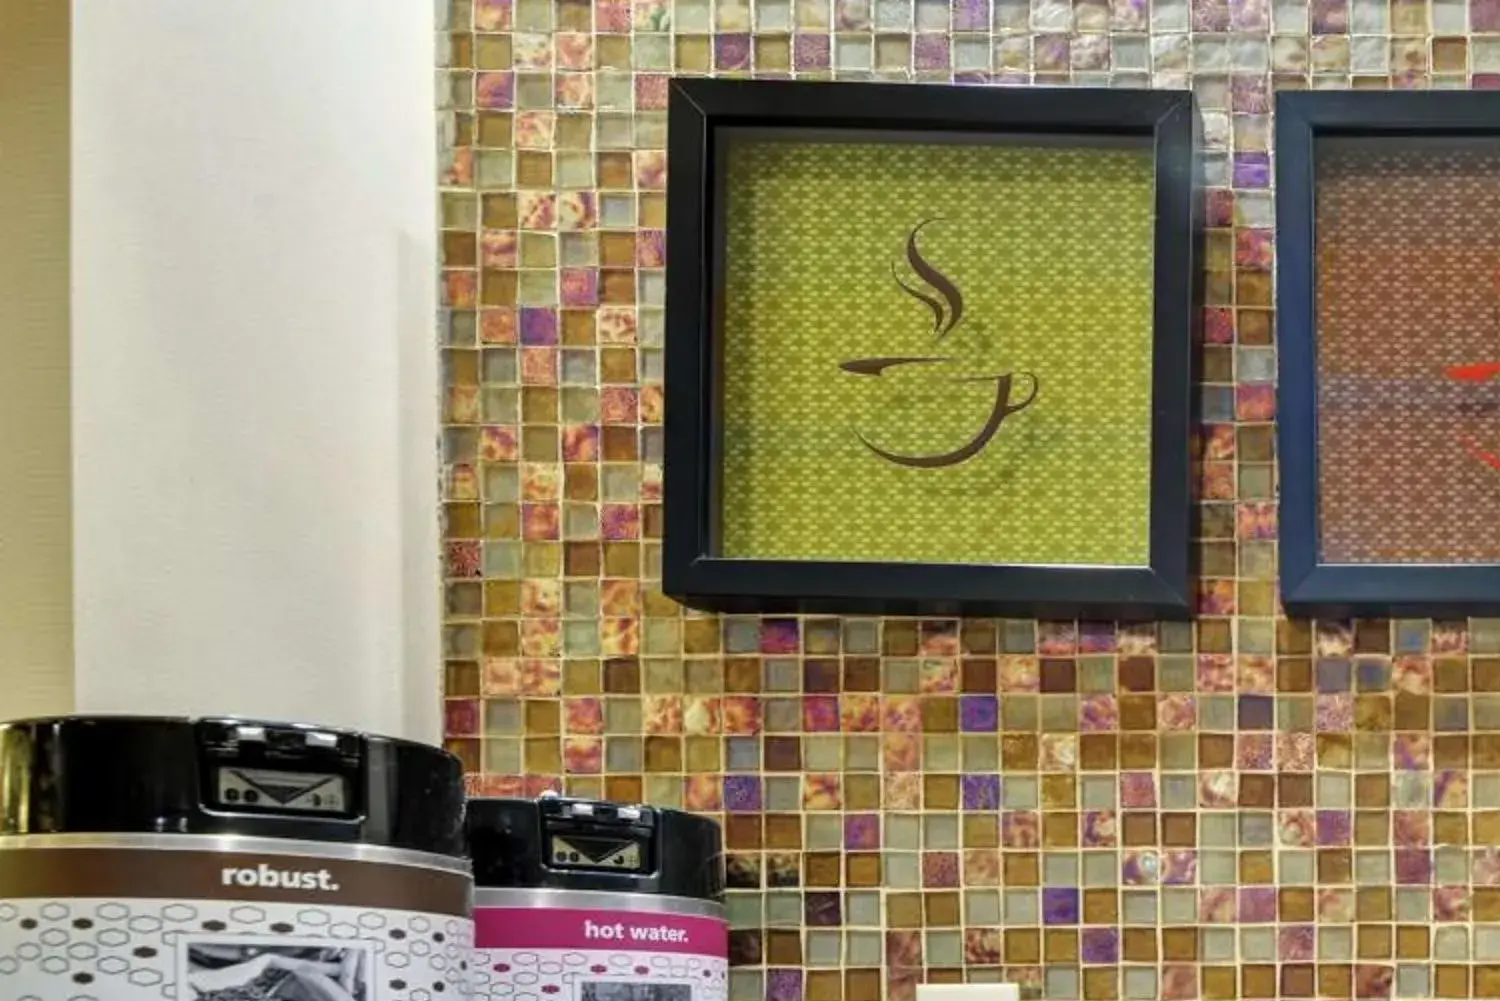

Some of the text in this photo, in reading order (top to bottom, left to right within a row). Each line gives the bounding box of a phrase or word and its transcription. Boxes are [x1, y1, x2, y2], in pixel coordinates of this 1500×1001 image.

[221, 863, 340, 891] robust.
[584, 919, 689, 943] hot water.
